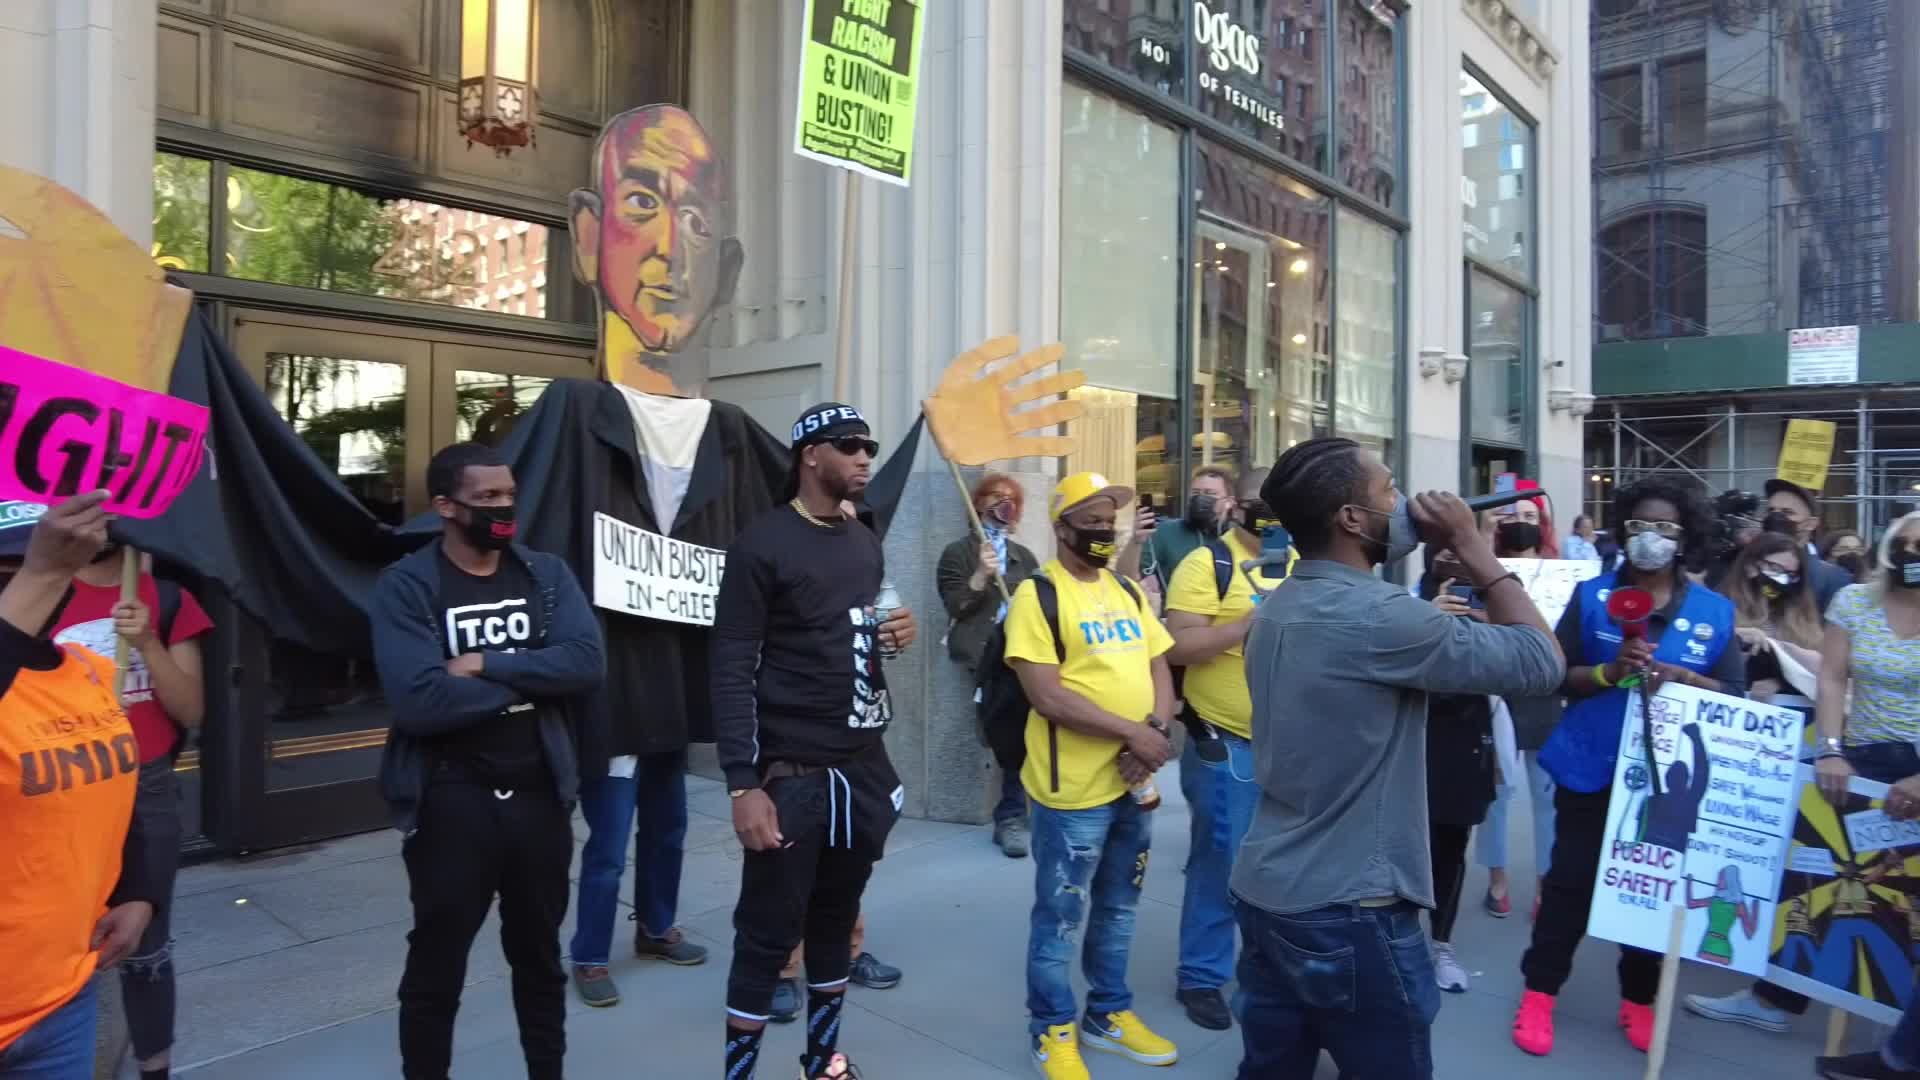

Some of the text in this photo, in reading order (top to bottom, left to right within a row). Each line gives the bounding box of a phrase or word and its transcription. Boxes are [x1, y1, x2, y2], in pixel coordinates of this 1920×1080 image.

[830, 15, 897, 66] RACISM
[824, 53, 836, 87] &
[842, 59, 892, 105] UNION
[1199, 72, 1219, 92] OF
[1223, 85, 1285, 129] TEXTILES
[816, 91, 893, 144] BUSTING!
[598, 516, 664, 577] UNION
[625, 580, 718, 621] IN-CHIE
[1696, 698, 1794, 739] MAY DAY
[1631, 731, 1674, 754] PCE
[1611, 838, 1675, 870] PUBLIC
[1603, 866, 1678, 902] SAFETY
